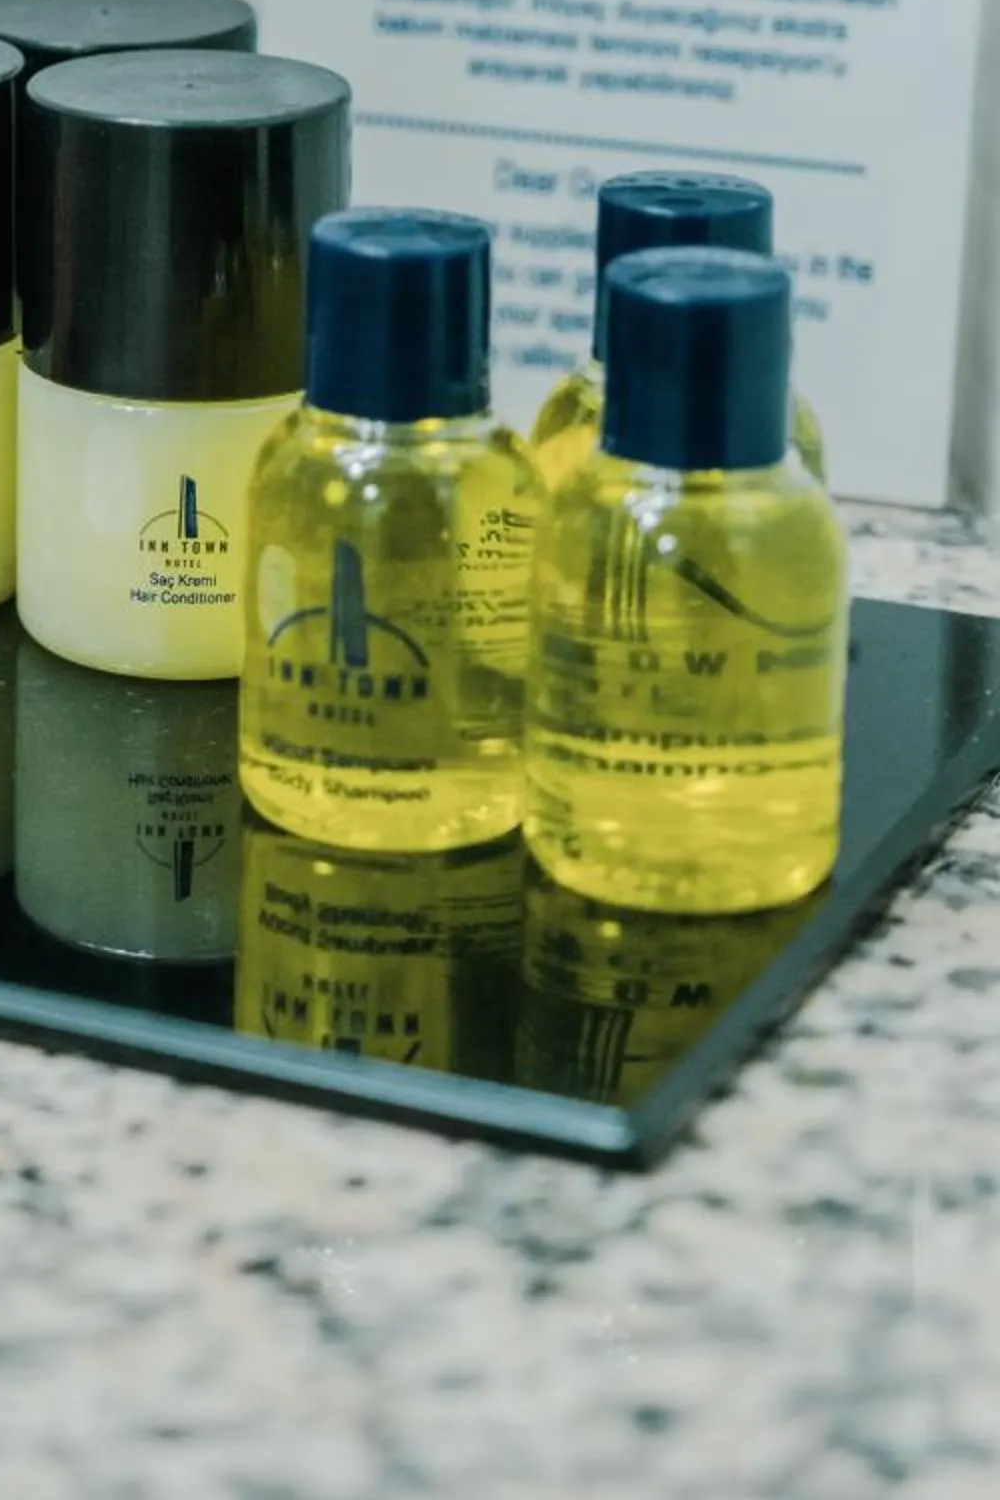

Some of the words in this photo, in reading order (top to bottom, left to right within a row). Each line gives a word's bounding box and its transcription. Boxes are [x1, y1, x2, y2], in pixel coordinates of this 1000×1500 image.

[139, 538, 169, 553] INN
[181, 540, 229, 554] TOWN
[149, 571, 175, 589] Saç
[178, 573, 217, 587] Kremi
[129, 587, 157, 602] Hair
[160, 589, 236, 605] Conditioner
